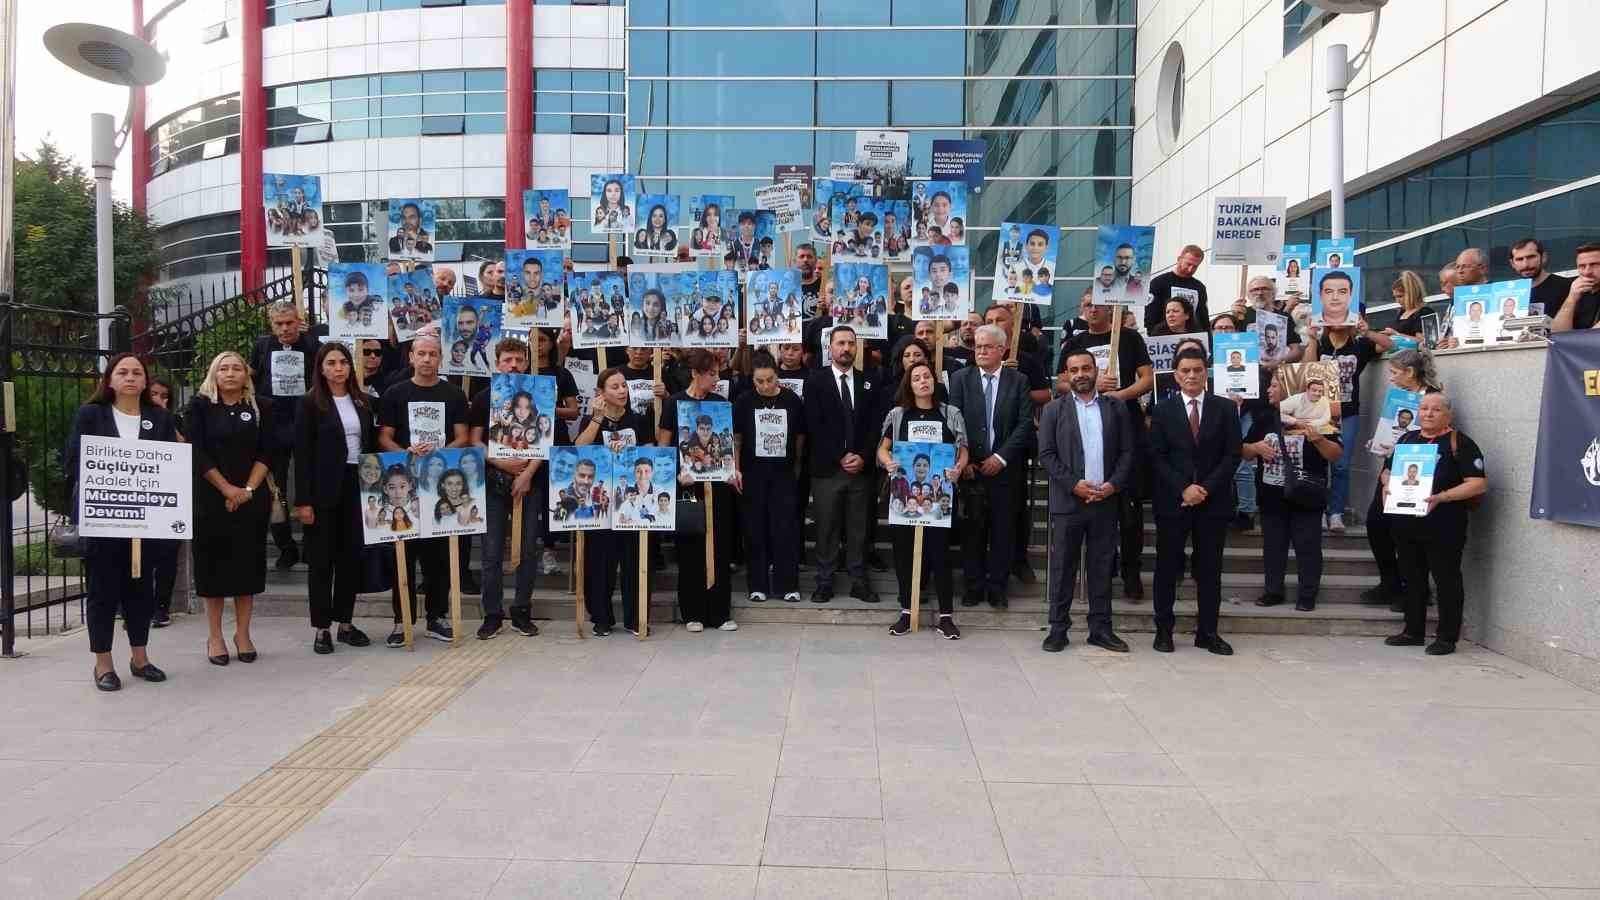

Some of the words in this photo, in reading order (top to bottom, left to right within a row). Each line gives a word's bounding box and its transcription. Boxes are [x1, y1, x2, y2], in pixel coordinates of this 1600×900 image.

[1218, 203, 1262, 214] TURİZM
[1217, 215, 1281, 226] BAKANLIĞI
[1216, 230, 1261, 239] NEREDE
[86, 445, 132, 458] Birlikte
[136, 449, 172, 461] Daha
[86, 459, 159, 475] Güçlüyüz!
[86, 474, 132, 487] Adalet
[86, 490, 176, 507] Mücadeleye
[86, 506, 144, 519] Devam!
